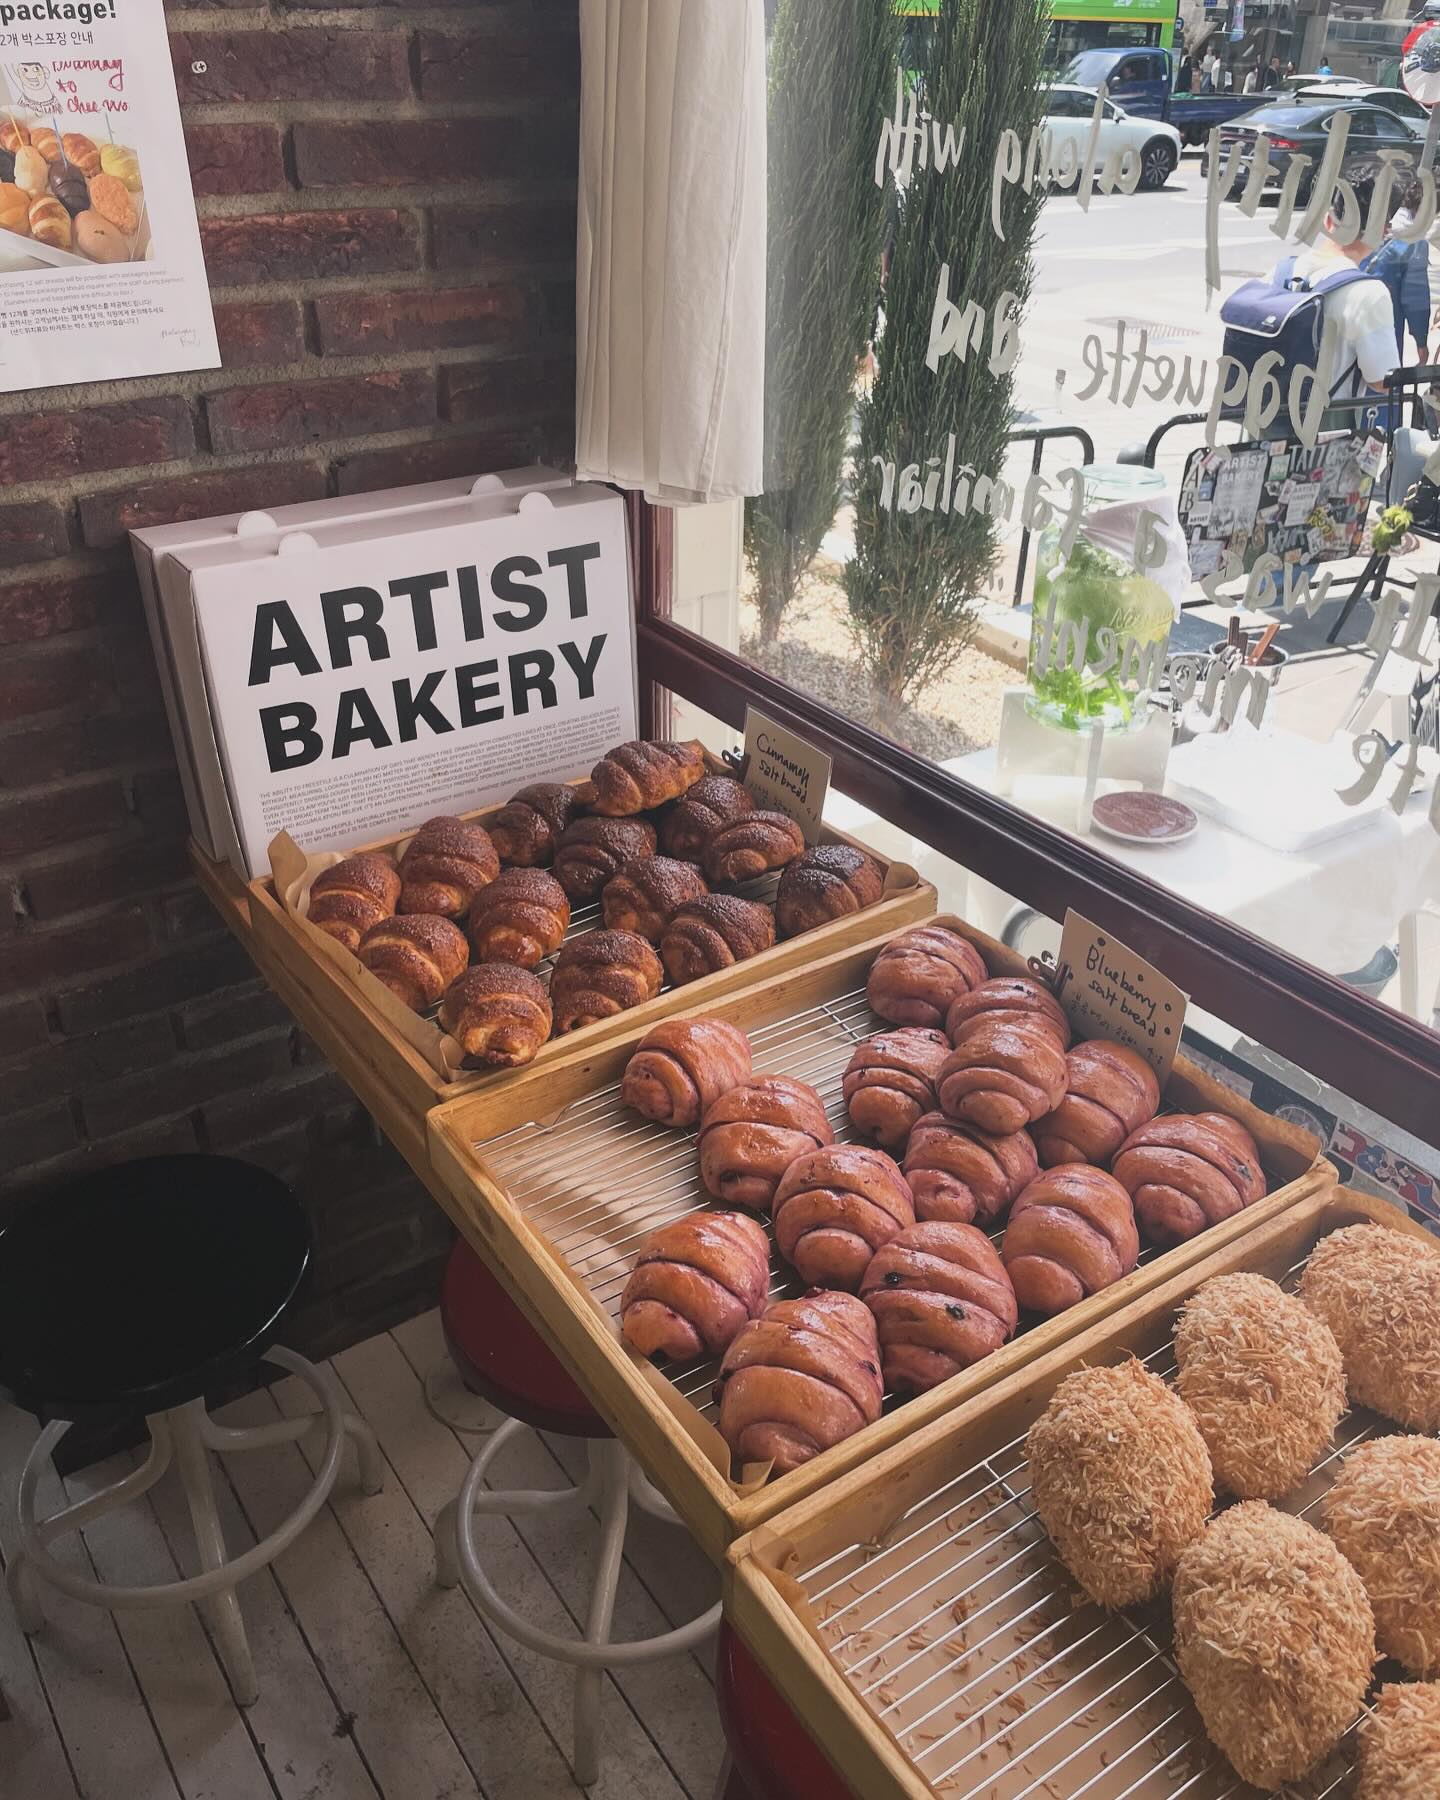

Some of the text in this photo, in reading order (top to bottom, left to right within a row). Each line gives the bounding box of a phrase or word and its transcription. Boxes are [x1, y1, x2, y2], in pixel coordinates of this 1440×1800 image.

[0, 0, 116, 27] package!
[21, 32, 66, 46] 박스포장
[70, 31, 94, 46] 안내
[248, 542, 601, 687] ARTIST
[258, 633, 608, 773] BAKERY
